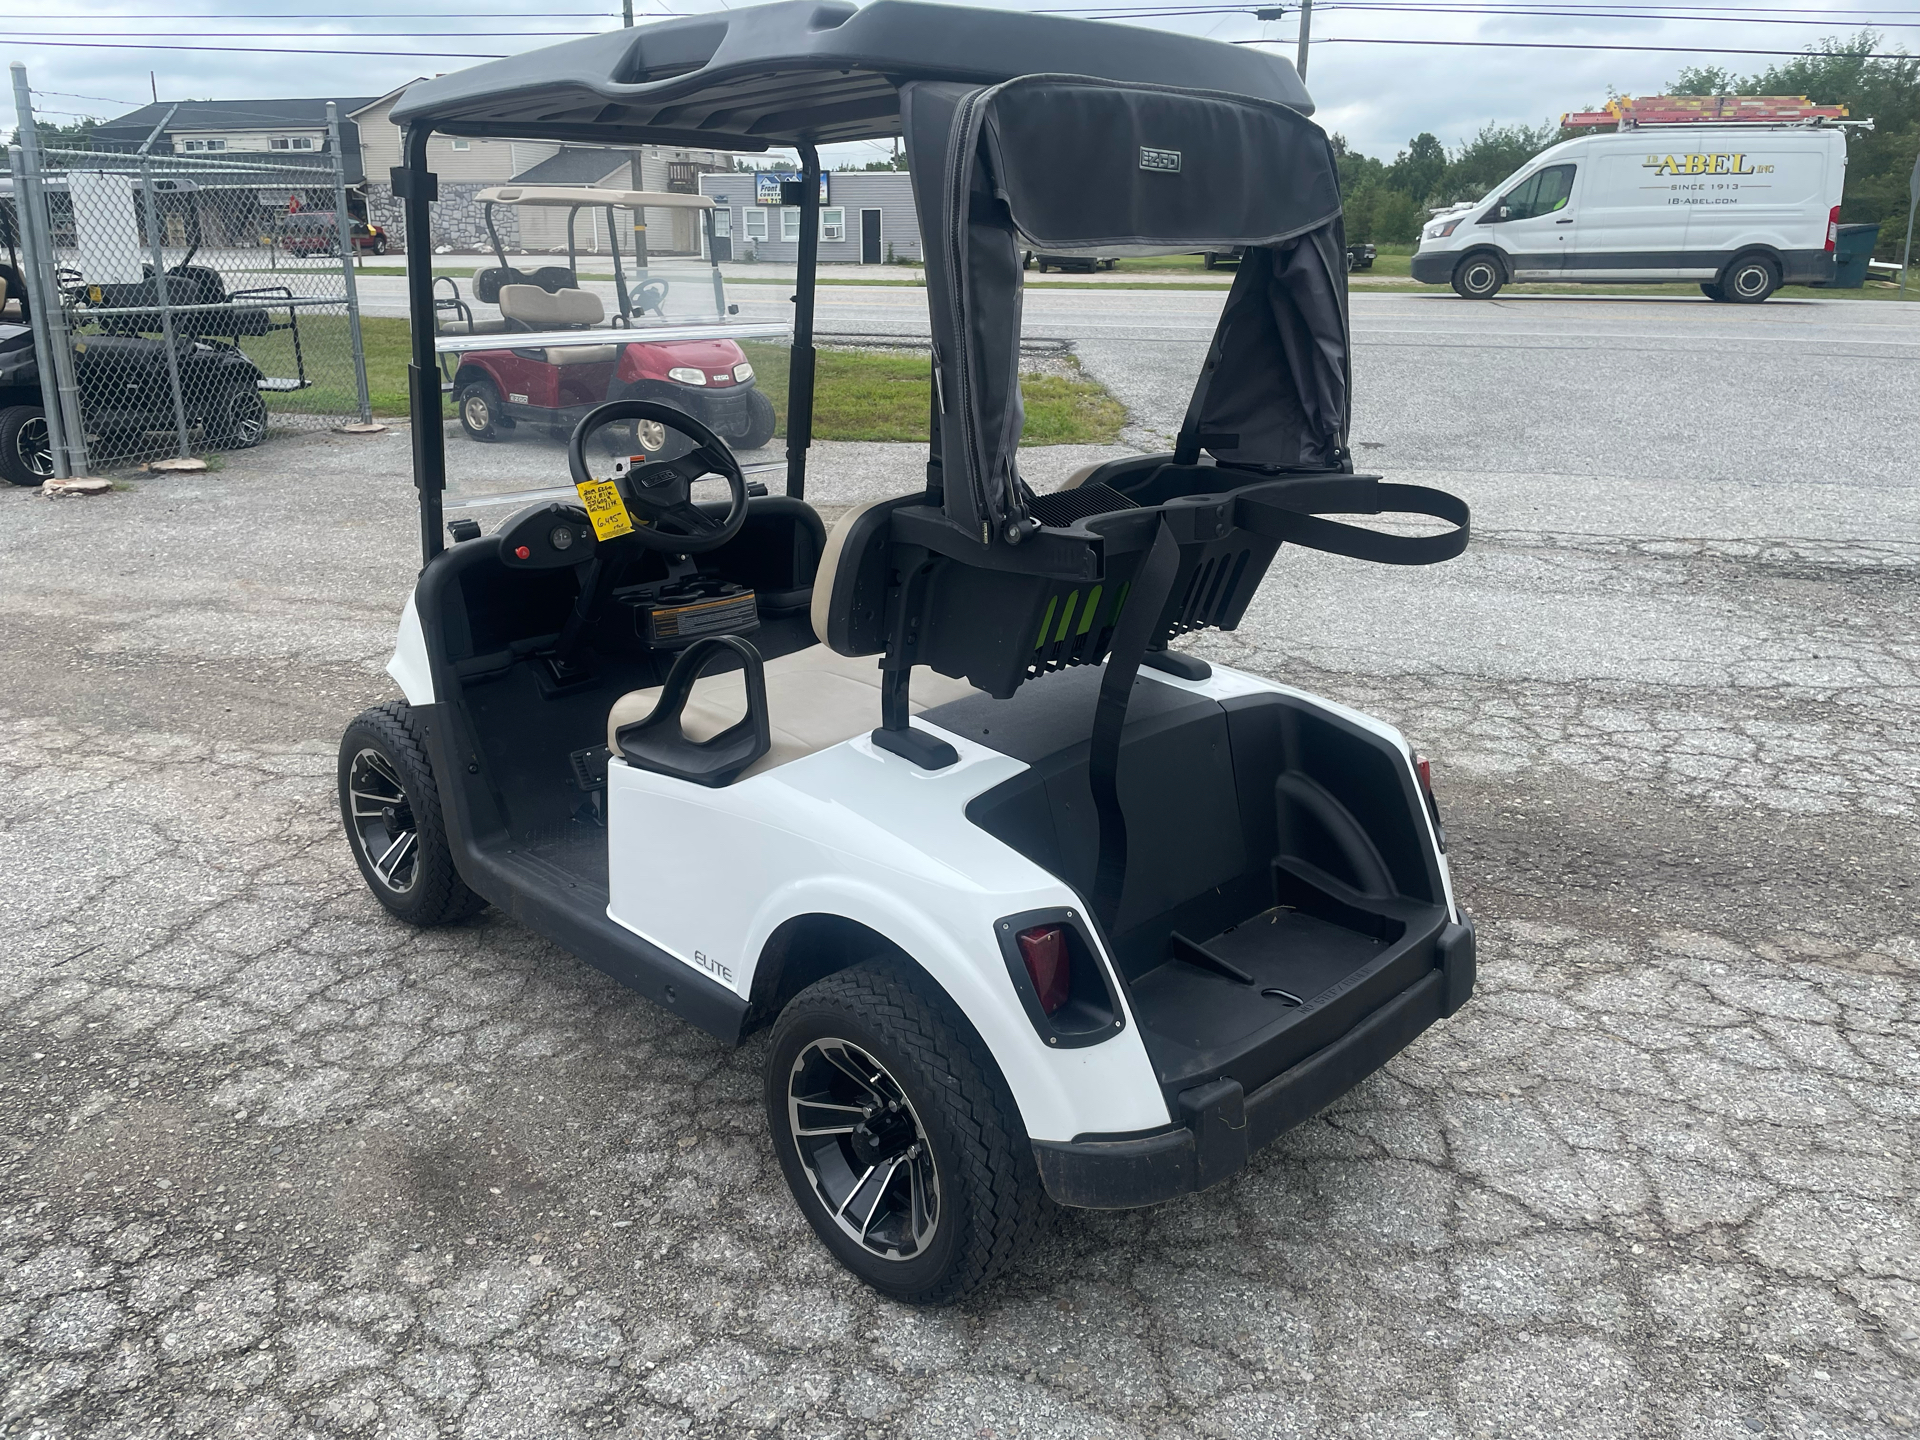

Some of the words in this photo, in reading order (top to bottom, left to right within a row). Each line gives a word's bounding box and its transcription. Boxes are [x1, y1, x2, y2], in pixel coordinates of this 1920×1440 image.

[1653, 153, 1755, 176] ABEL
[1756, 164, 1774, 174] INC
[760, 184, 778, 192] Front
